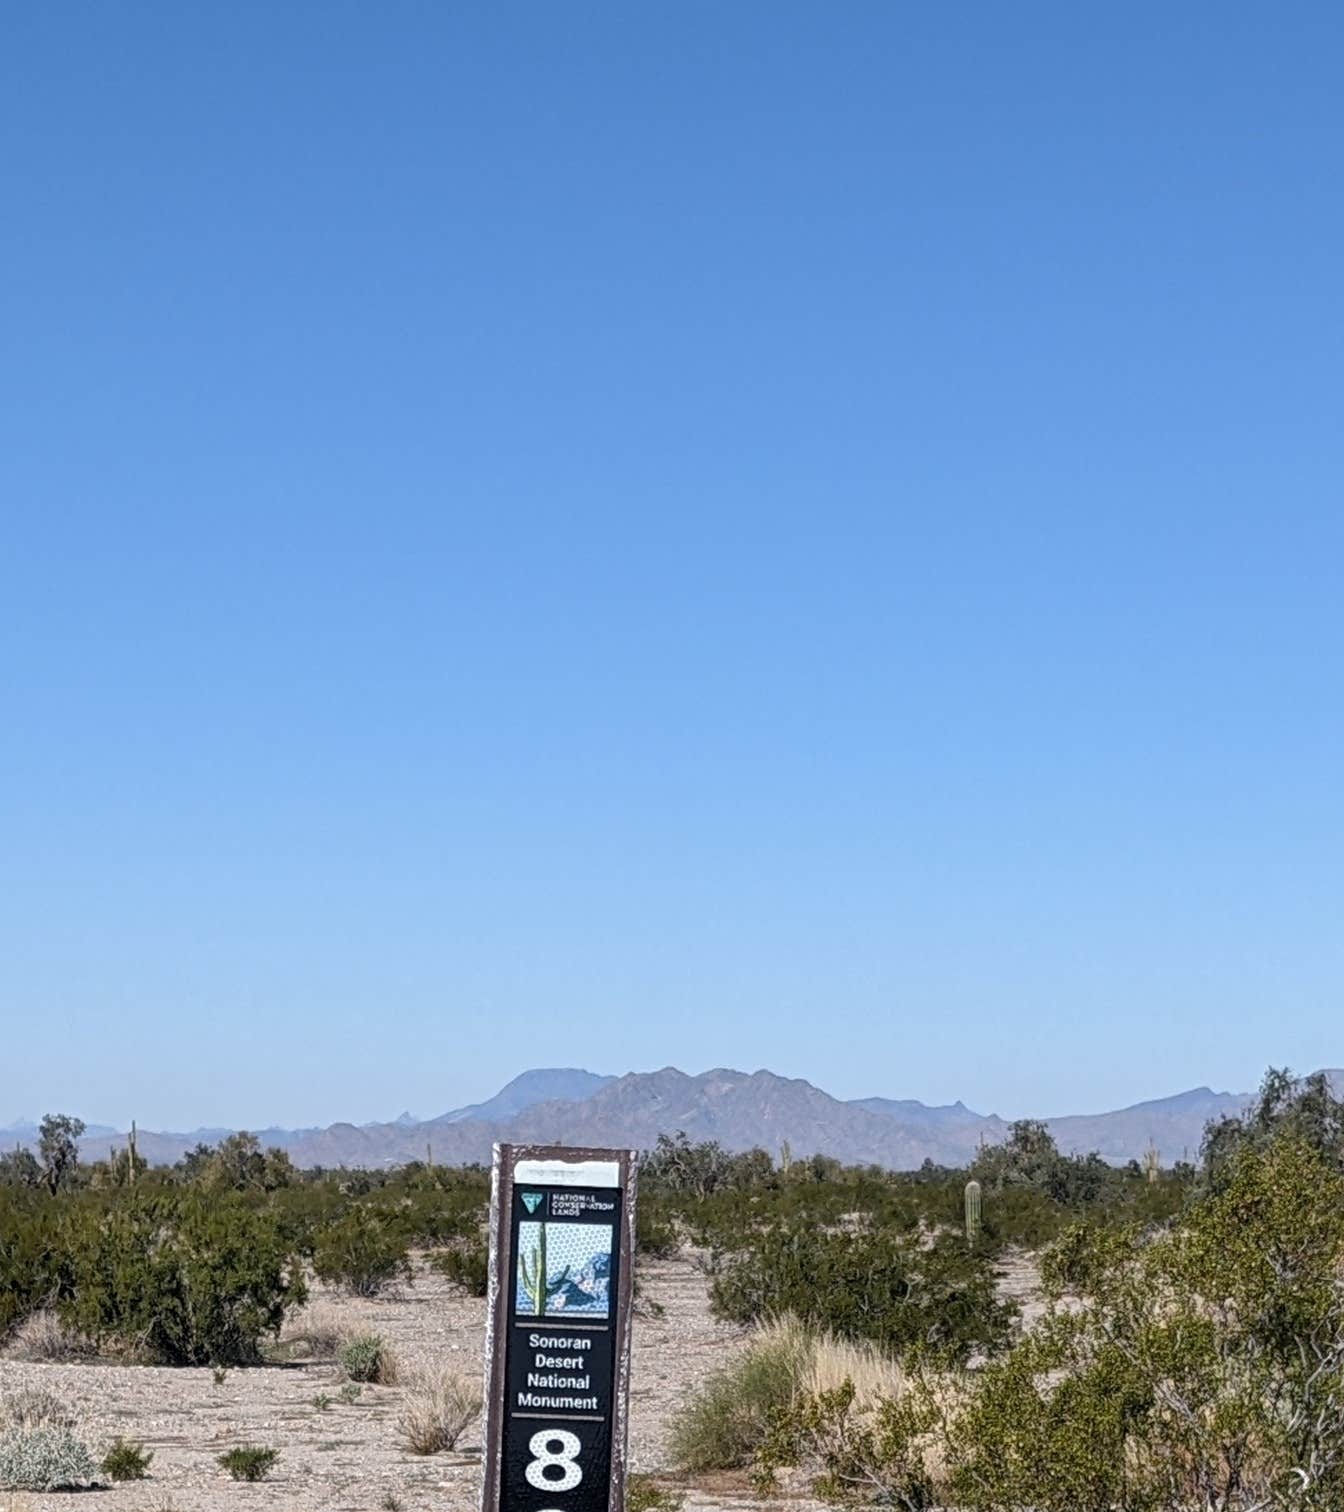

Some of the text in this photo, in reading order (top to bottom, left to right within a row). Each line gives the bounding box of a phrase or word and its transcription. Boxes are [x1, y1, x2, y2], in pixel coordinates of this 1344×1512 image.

[552, 1208, 581, 1216] LANDS
[529, 1334, 591, 1350] Sonoran
[535, 1354, 584, 1370] Desert
[527, 1373, 590, 1390] National
[518, 1393, 598, 1410] Monument
